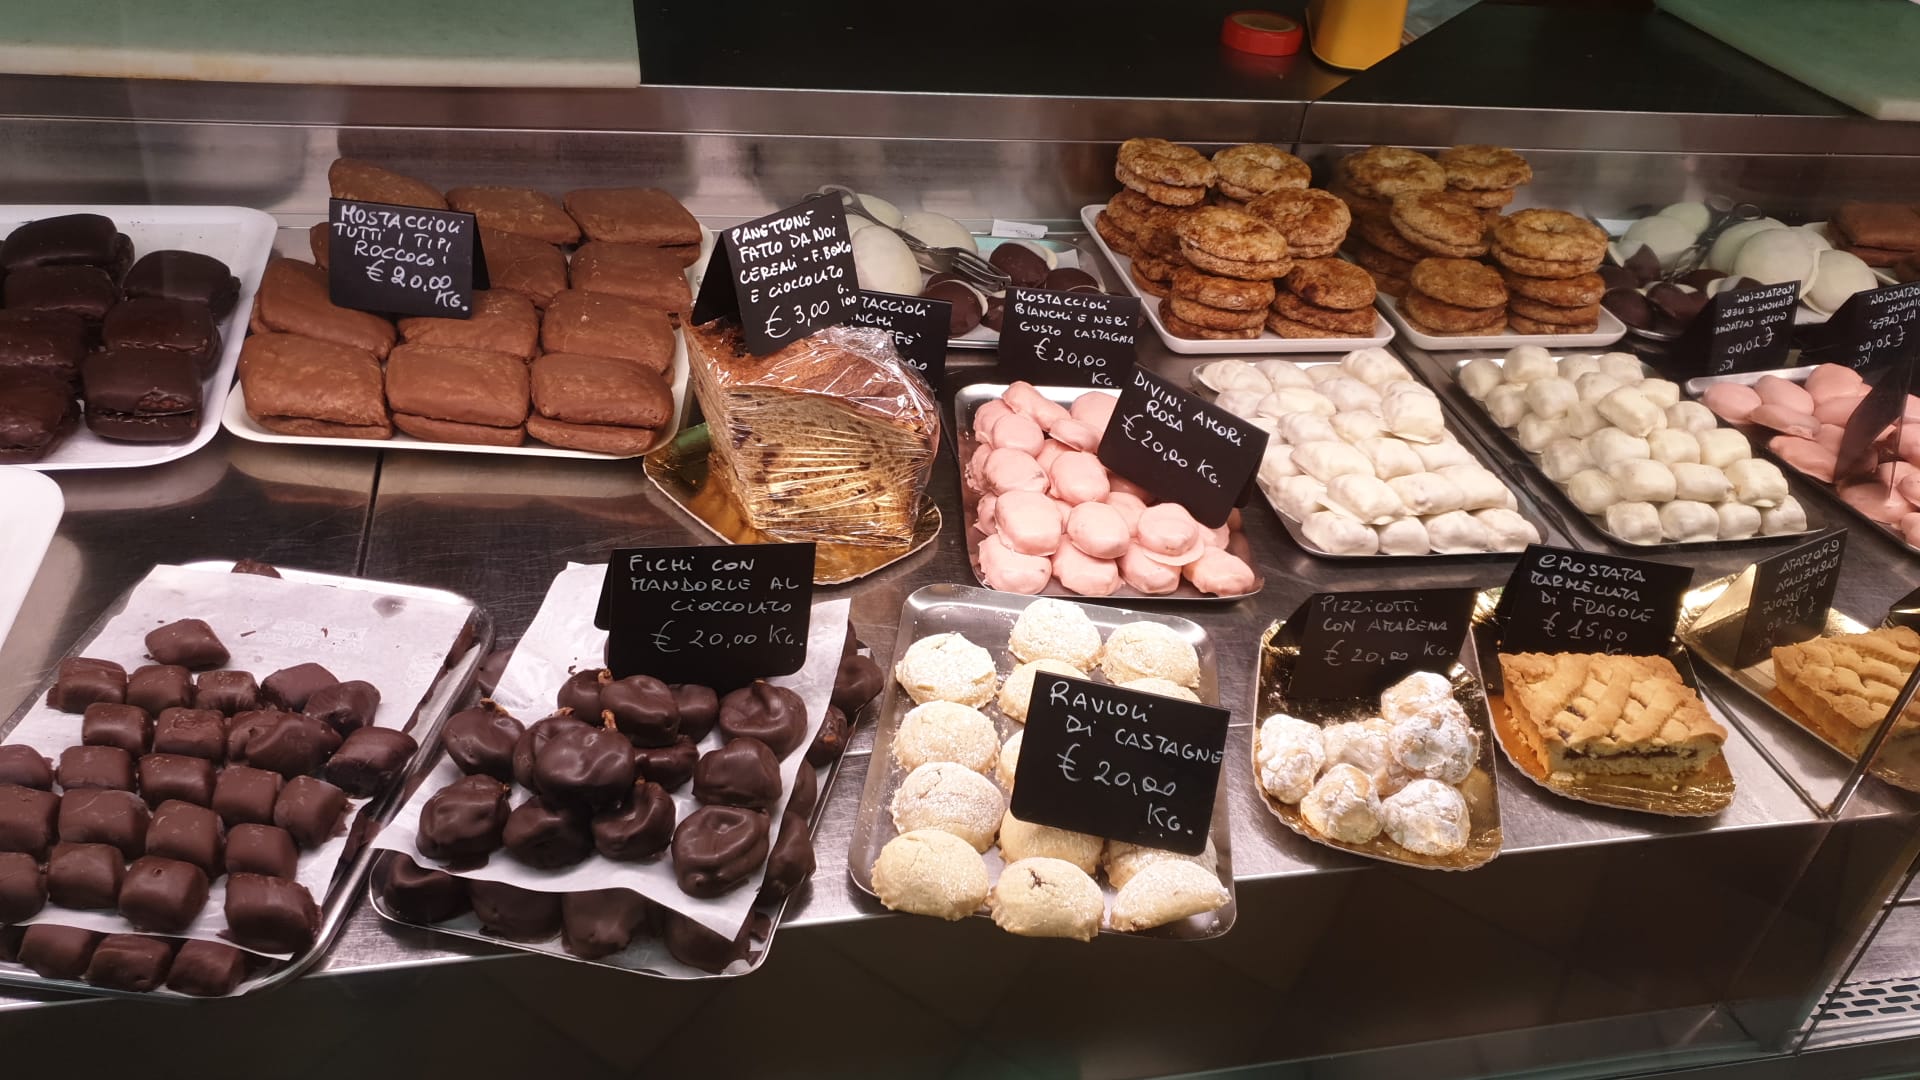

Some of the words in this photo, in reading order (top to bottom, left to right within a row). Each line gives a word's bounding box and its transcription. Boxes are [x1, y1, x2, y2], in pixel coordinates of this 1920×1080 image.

[341, 204, 465, 234] MOSTACCIOLI
[732, 210, 815, 246] PANETTONE
[333, 223, 386, 241] TUTTI
[414, 233, 452, 252] TIPI
[738, 241, 783, 264] FATTO
[790, 233, 812, 249] DA
[813, 219, 836, 242] NOI
[391, 266, 452, 292] 20,00
[740, 254, 798, 285] CEREALI
[750, 289, 759, 303] E
[768, 265, 844, 298] CIOCCOLATO
[793, 300, 830, 327] 3,00
[840, 295, 857, 308] 100
[861, 296, 931, 317] TACCIOLI
[1015, 303, 1071, 321] BIANCHI
[1078, 314, 1087, 322] E
[1094, 316, 1130, 326] NERI
[1016, 290, 1110, 310] MOSTACCIOLI
[1019, 322, 1062, 336] GUSTO
[1074, 329, 1134, 344] CASTAGNA
[1054, 348, 1107, 368] 20,00
[1134, 371, 1187, 412] DIVINI
[1193, 411, 1247, 446] AMORI
[1146, 400, 1183, 432] ROSA
[629, 555, 695, 571] FICHI
[712, 558, 755, 571] CON
[1538, 554, 1646, 583] CROSTATA
[630, 577, 752, 592] MANDORLE
[770, 577, 800, 589] AL
[1530, 571, 1640, 602] MARMELLATA
[671, 599, 792, 614] CIOCCOLATO
[1320, 596, 1423, 614] PIZZICOTTI
[1541, 590, 1560, 605] DI
[1572, 597, 1655, 622] FRAGOLE
[689, 630, 758, 648] 20,00
[1323, 617, 1356, 633] CON
[1366, 618, 1448, 633] AMARENA
[1050, 681, 1153, 722] RAVIOLI
[1066, 715, 1097, 736] DI
[1115, 728, 1225, 764] CASTAGNE
[1093, 761, 1176, 796] 20,00
